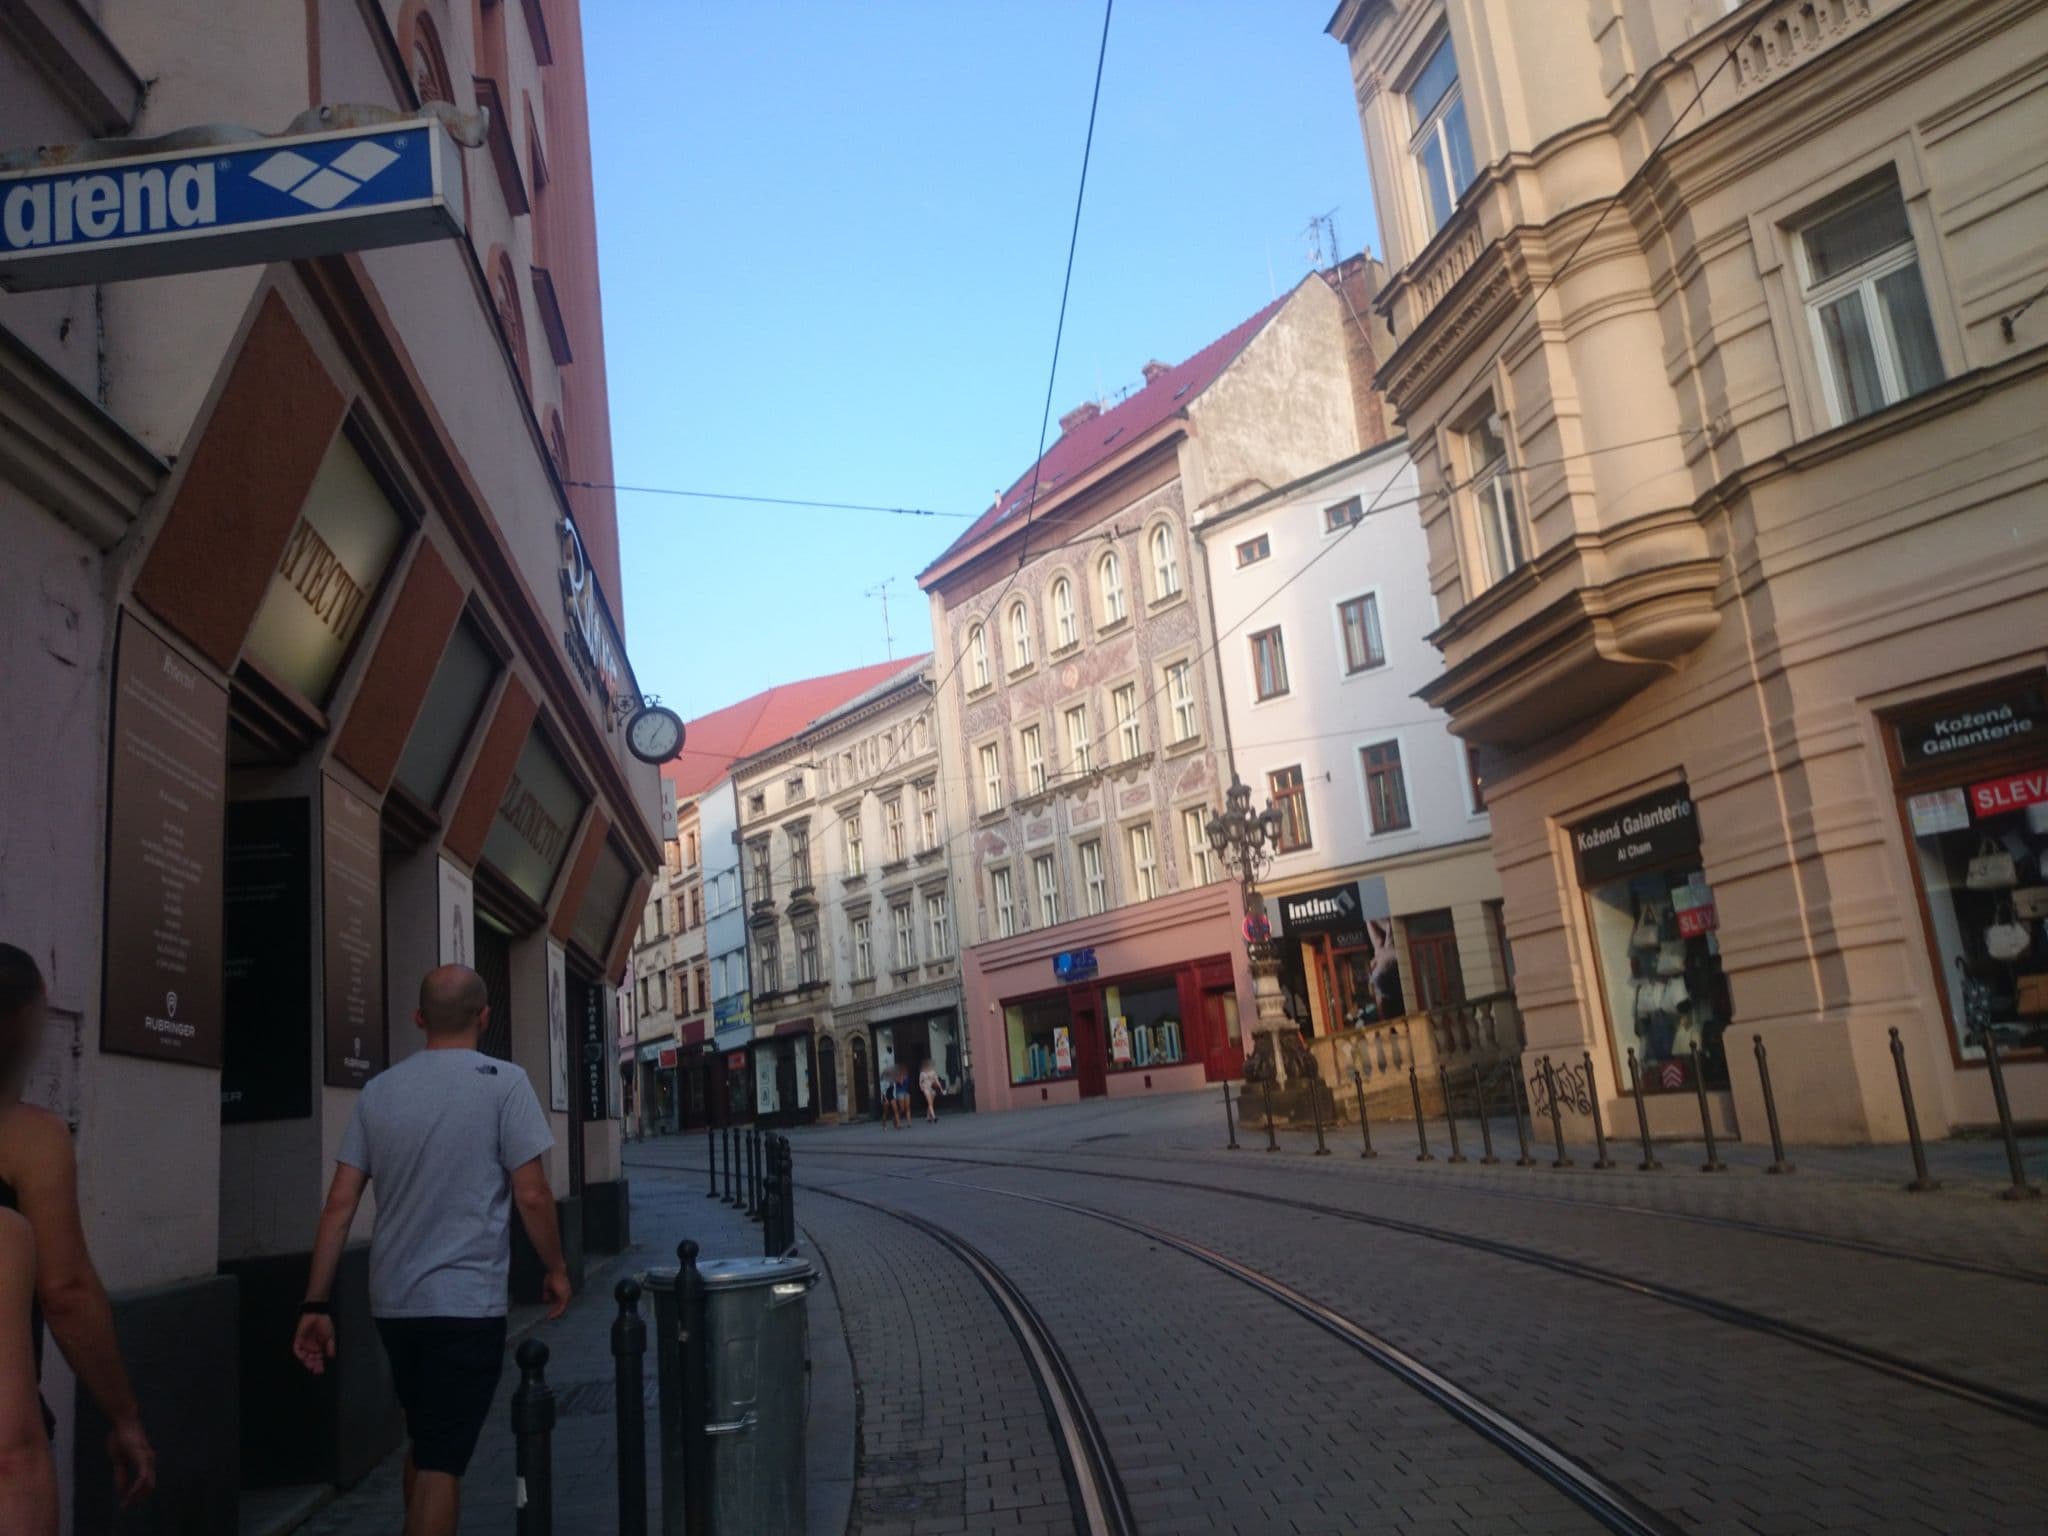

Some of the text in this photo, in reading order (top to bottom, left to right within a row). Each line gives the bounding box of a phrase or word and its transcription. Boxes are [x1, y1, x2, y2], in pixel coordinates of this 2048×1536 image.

[3, 161, 217, 248] arena
[1935, 703, 2013, 735] Kožená
[1922, 719, 2033, 755] Galanterie
[1977, 774, 2048, 809] SLEV
[1577, 798, 1691, 852] Kožená Galanterie
[145, 1016, 196, 1037] RUBRINGER
